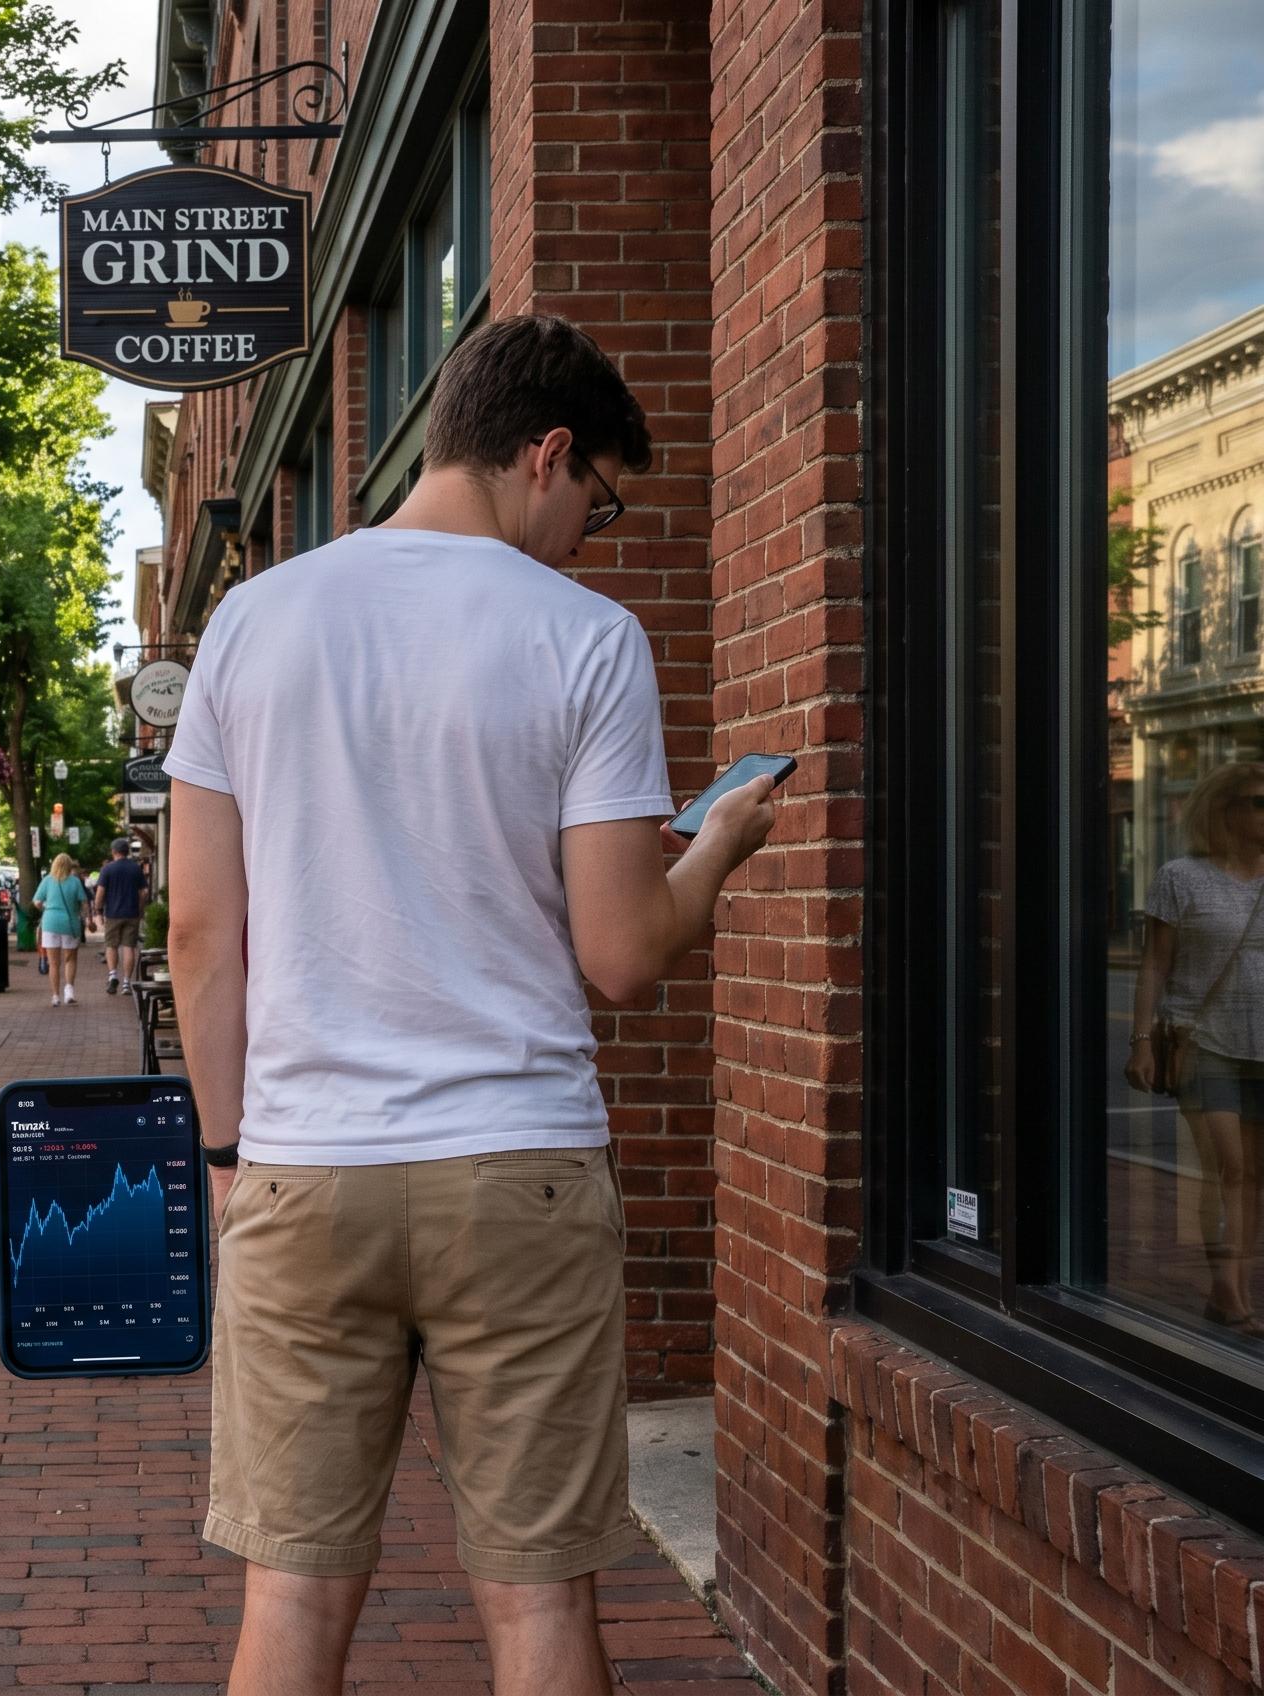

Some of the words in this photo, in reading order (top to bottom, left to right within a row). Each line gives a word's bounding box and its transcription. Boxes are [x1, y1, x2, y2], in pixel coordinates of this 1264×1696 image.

[82, 208, 166, 232] MAIN
[174, 206, 289, 231] STREET
[81, 238, 290, 285] GRIND
[115, 334, 258, 363] COFFEE
